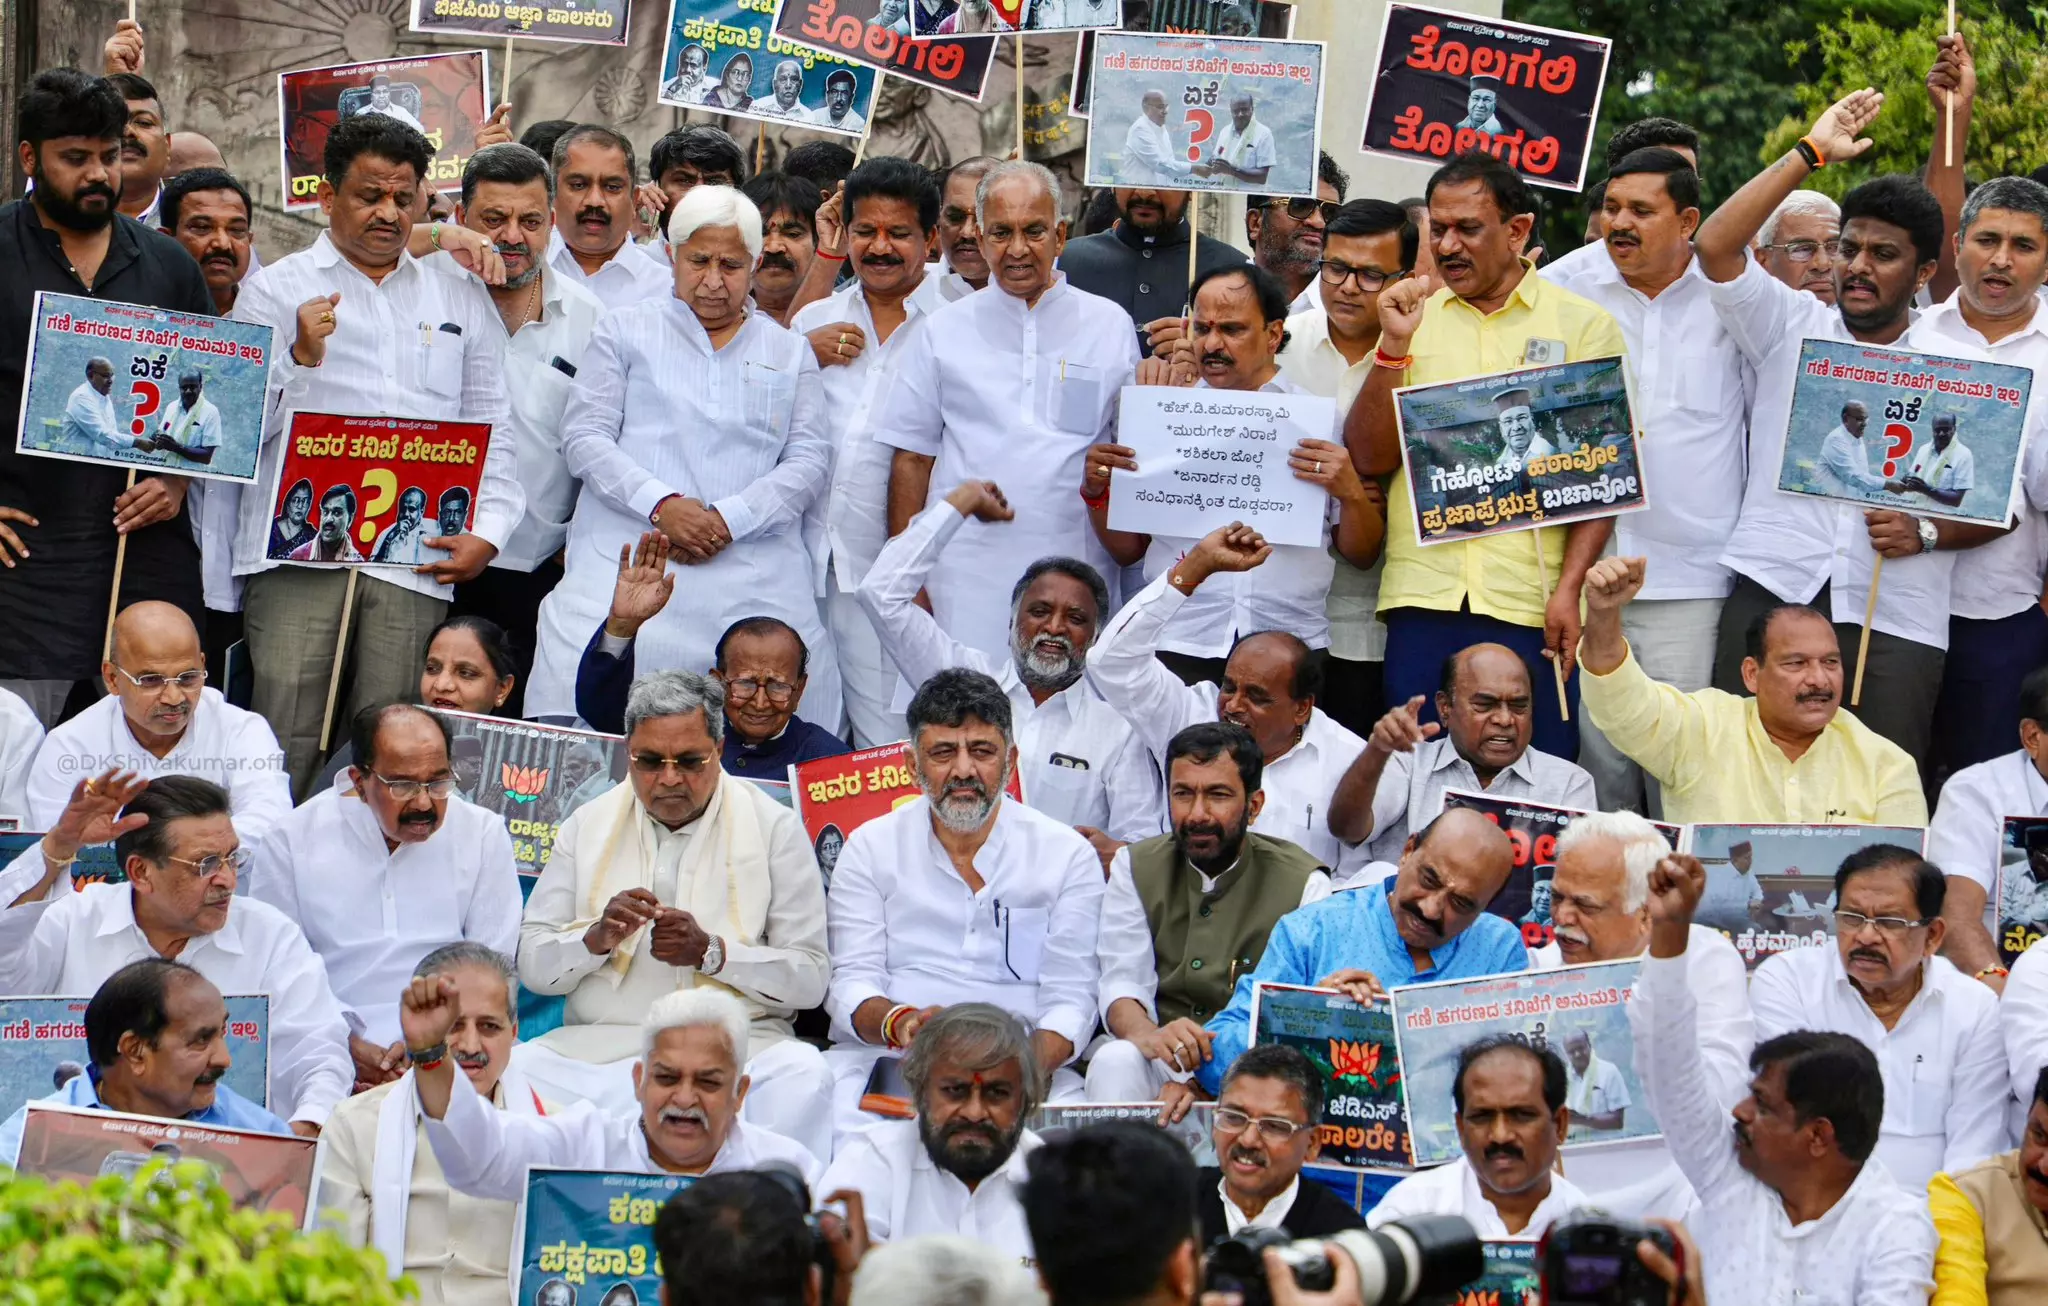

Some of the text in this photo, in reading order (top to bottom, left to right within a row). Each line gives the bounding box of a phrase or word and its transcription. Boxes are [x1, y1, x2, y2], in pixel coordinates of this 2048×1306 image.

[547, 8, 612, 27] ಪಾಲಕರು
[683, 17, 763, 51] ಪಕ್ಷಪಾತಿ
[1446, 21, 1550, 46] ಕರ್ನಾಟಕ ಪ್ರದೇಶ ಕಾಂಗ್ರೆಸ್ ಸಮಿತಿ
[1104, 51, 1312, 84] ಗಣಿ ಹಗರಣದ ತನಿಖೆಗೆ ಅನುಮತಿ ಇಲ್ಲ
[1406, 24, 1577, 94] ತೊಲಗಲಿ
[1183, 80, 1219, 107] ಏಕೆ
[1184, 108, 1215, 162] ?
[46, 313, 264, 366] ಗಣಿ ಹಗರಣದ ತನಿಖೆಗೆ ಅನುಮತಿ ಇಲ್ಲ
[130, 353, 168, 379] ಏಕೆ
[1806, 359, 2021, 407] ಗಣಿ ಹಗರಣದ ತನಿಖೆಗೆ ಅನುಮತಿ ಇಲ್ಲ
[130, 380, 161, 436] ?
[1883, 396, 1923, 423] ಏಕೆ
[344, 418, 438, 431] ಕರ್ನಾಟಕ ಪ್ರದೇಶ ಕಾಂಗ್ರೆಸ್ ಸಮಿತಿ
[1239, 427, 1277, 441] ನಿರಾಣಿ
[296, 433, 477, 464] ಇವರ ತನಿಖೆ ಬೇಡವೇ
[1527, 442, 1619, 478] ಹಠಾವೋ
[1882, 423, 1913, 479] ?
[1241, 474, 1261, 492] ರೆಡ್ಡಿ
[358, 468, 398, 543] ?
[1136, 489, 1293, 515] ಸಂವಿಧಾನಕ್ಕಿಂತ ದೊಡ್ಡವರಾ?
[1422, 473, 1638, 535] ಪ್ರಜಾಪ್ರಭುತ್ವ ಬಚಾವೋ
[476, 722, 587, 744] ಕರ್ನಾಟಕ ಪ್ರದೇಶ ಕಾಂಗ್ರೆಸ್ ಸಮಿತಿ
[852, 747, 899, 762] ಕರ್ನಾಟಕ ಪ್ರದೇಶ
[808, 771, 861, 803] ಇವರ
[1505, 808, 1557, 823] ಕರ್ನಾಟಕ ಪ್ರದೇಶ
[1407, 1007, 1432, 1030] ಗಣಿ
[1436, 1003, 1500, 1026] ಹಗರಣದ
[1503, 995, 1553, 1018] ತನಿಖೆಗೆ
[1556, 988, 1618, 1010] ಅನುಮತಿ
[2, 1019, 88, 1041] ಗಣಿ ಹಗರಣ
[230, 1021, 260, 1042] ಇಲ್ಲ
[1061, 1109, 1093, 1118] ಕರ್ನಾಟಕ
[1093, 1109, 1116, 1119] ಪ್ರದೇಶ
[1329, 1095, 1398, 1121] ಜೆಡಿಎಸ್
[102, 1122, 240, 1144] ಕರ್ನಾಟಕ ಪ್ರದೇಶ ಕಾಂಗ್ರೆಸ್ ಸಮಿತಿ
[539, 1239, 647, 1285] ಪಕ್ಷಪಾತಿ
